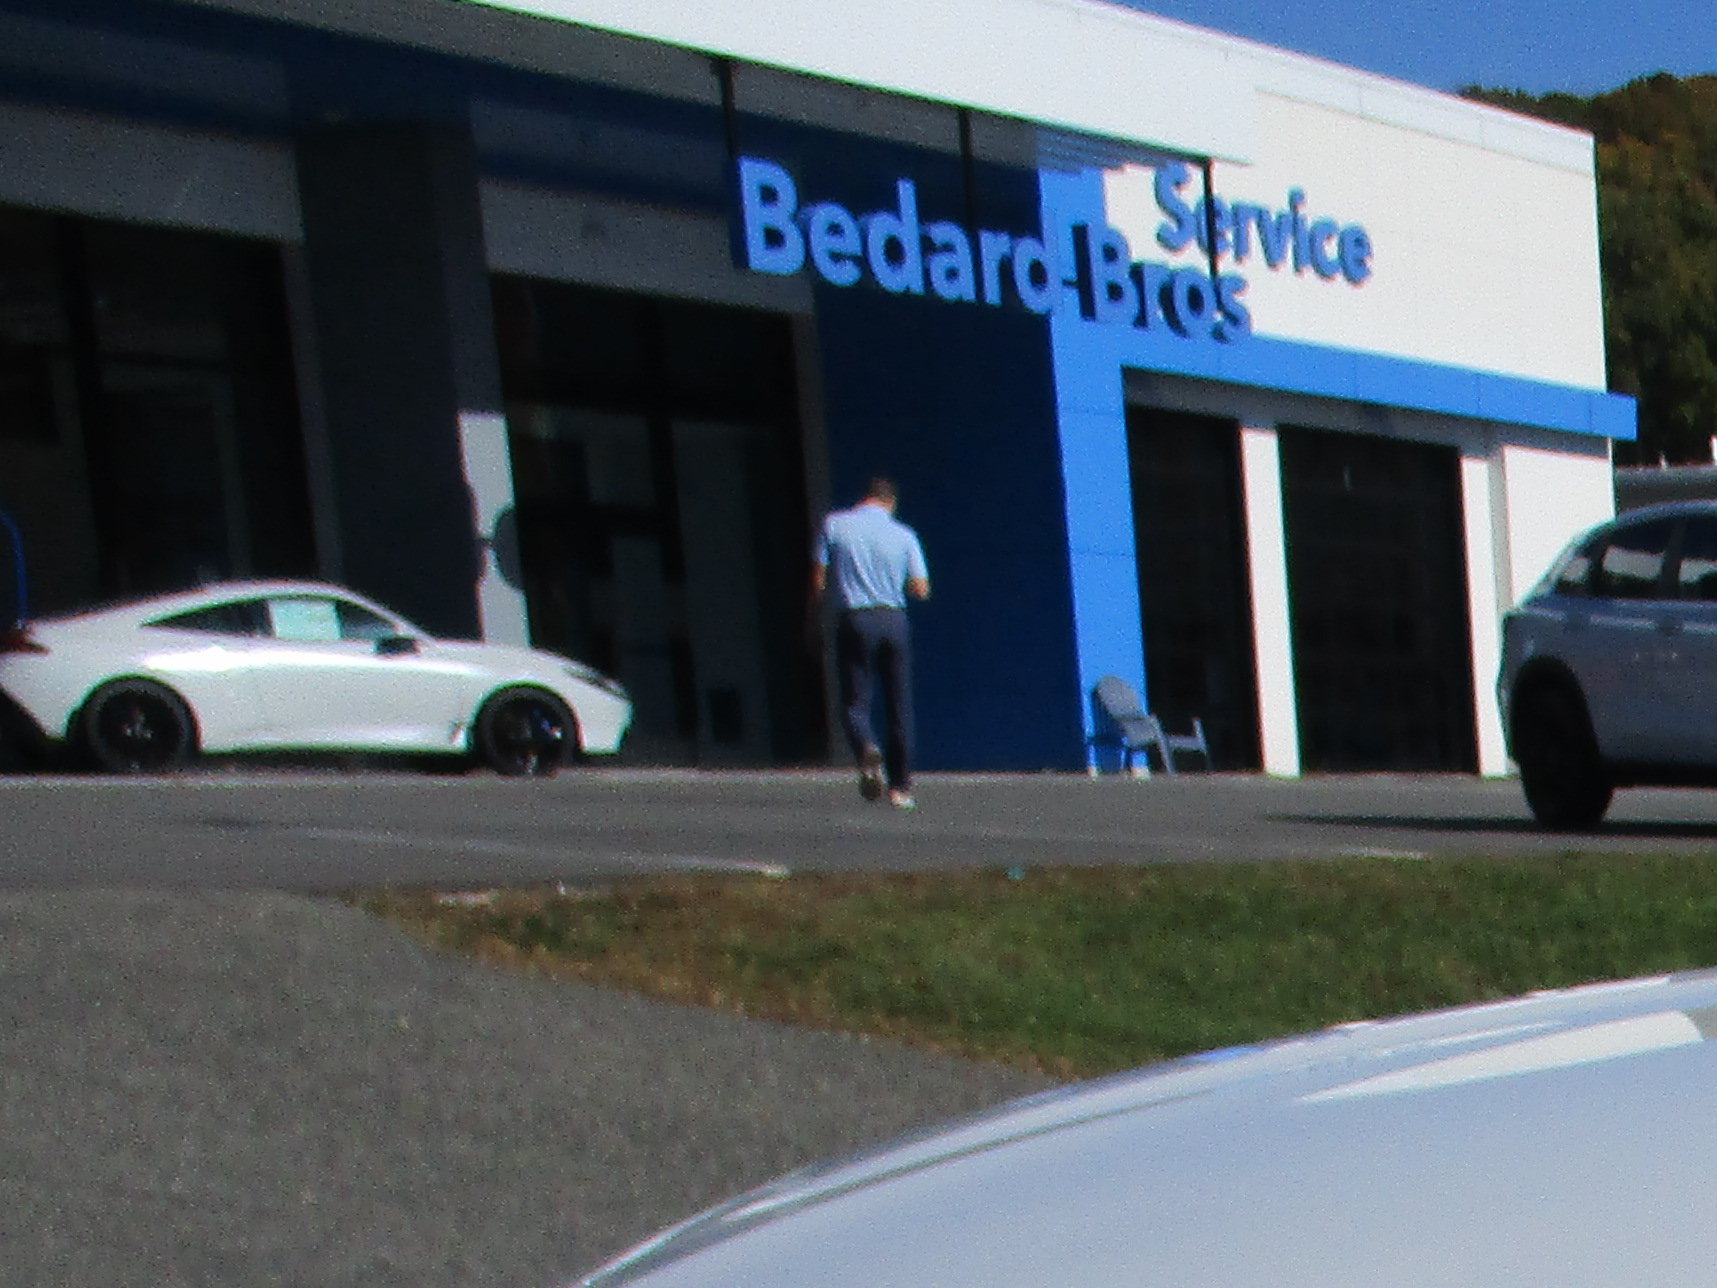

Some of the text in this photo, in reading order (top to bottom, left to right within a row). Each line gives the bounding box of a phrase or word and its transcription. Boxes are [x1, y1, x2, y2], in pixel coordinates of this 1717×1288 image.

[738, 154, 1253, 343] Bedard Bros
[1154, 162, 1374, 286] Service
